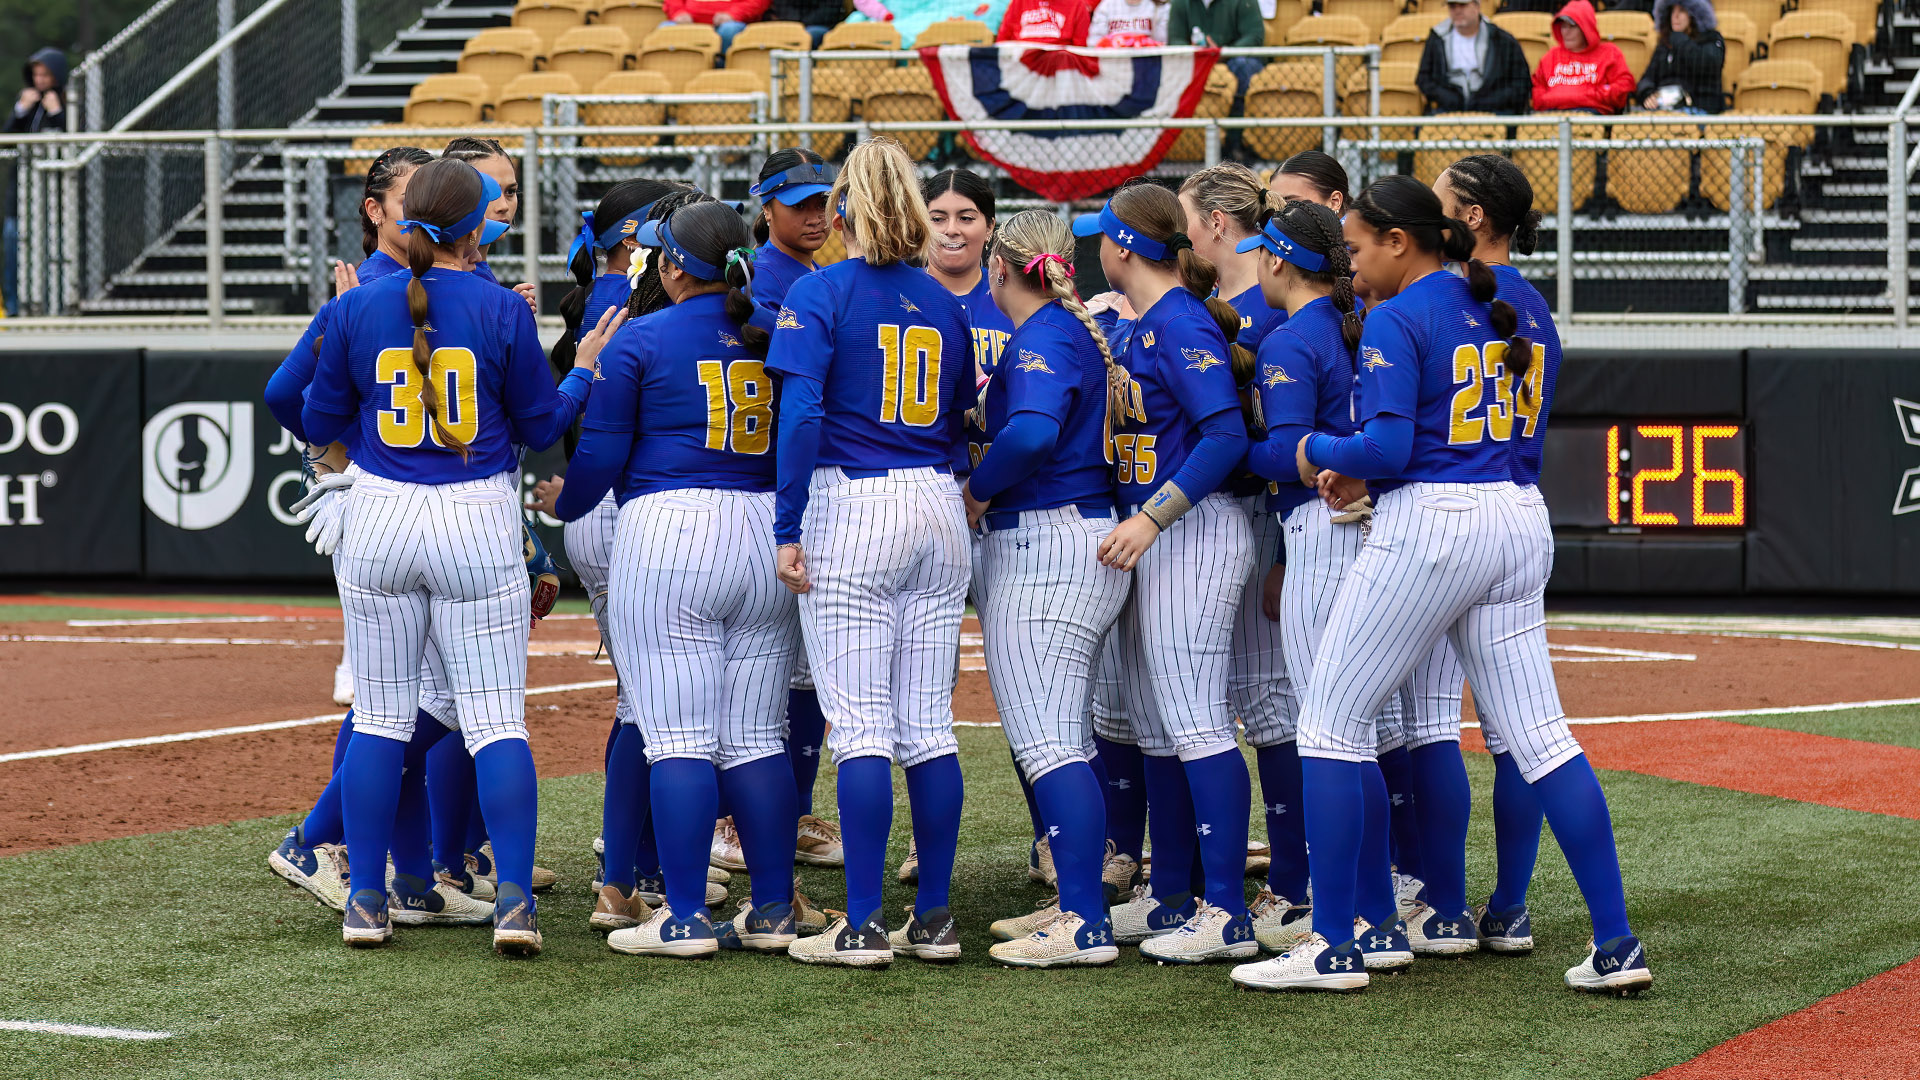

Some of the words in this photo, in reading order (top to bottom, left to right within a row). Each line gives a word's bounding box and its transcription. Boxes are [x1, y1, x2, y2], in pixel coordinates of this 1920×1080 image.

[375, 346, 479, 448] 30
[696, 359, 774, 455] 18
[877, 323, 943, 427] 10
[1447, 340, 1515, 445] 23
[1113, 433, 1158, 485] 55
[911, 928, 930, 941] UA
[1161, 913, 1187, 926] UA
[1600, 956, 1620, 970] UA
